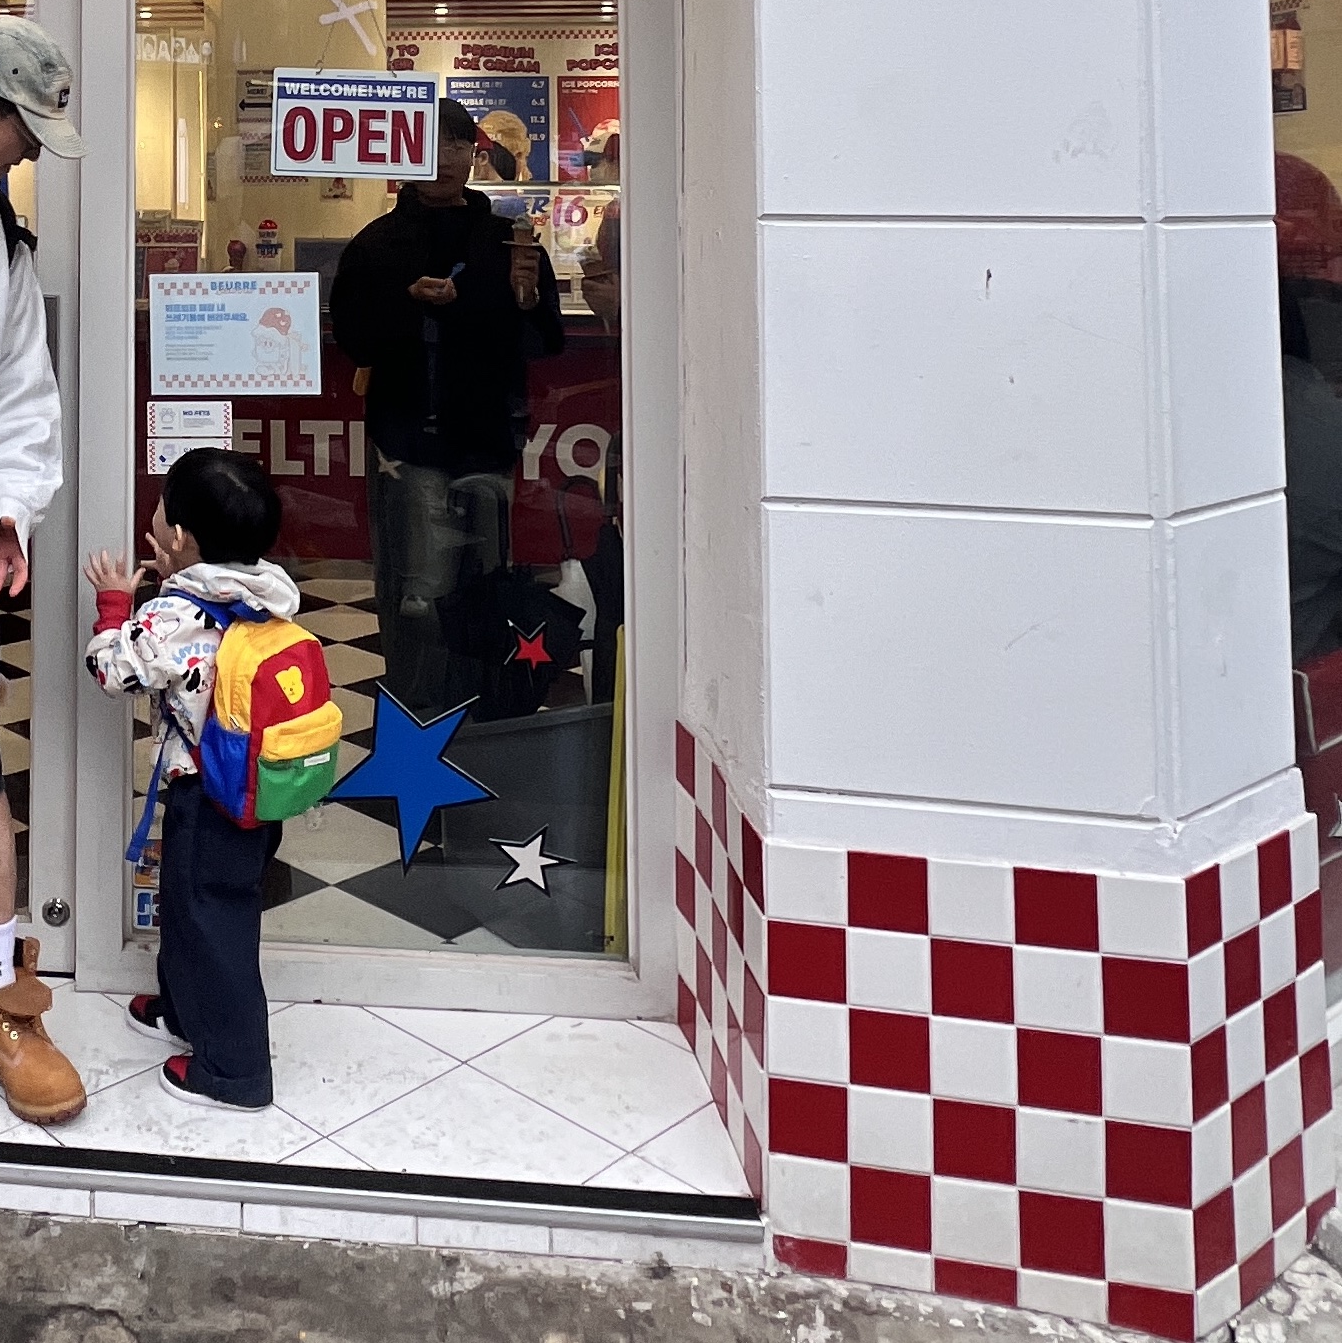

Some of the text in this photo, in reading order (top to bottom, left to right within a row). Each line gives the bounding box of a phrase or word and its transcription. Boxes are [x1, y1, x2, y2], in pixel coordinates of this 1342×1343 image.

[461, 44, 535, 60] PREMIUM
[453, 56, 541, 74] ICE CREAM
[284, 82, 374, 98] WELCOME!
[376, 84, 428, 99] WE'RE
[450, 80, 481, 90] SINGLE
[282, 106, 427, 166] OPEN
[210, 280, 258, 292] BEURRE
